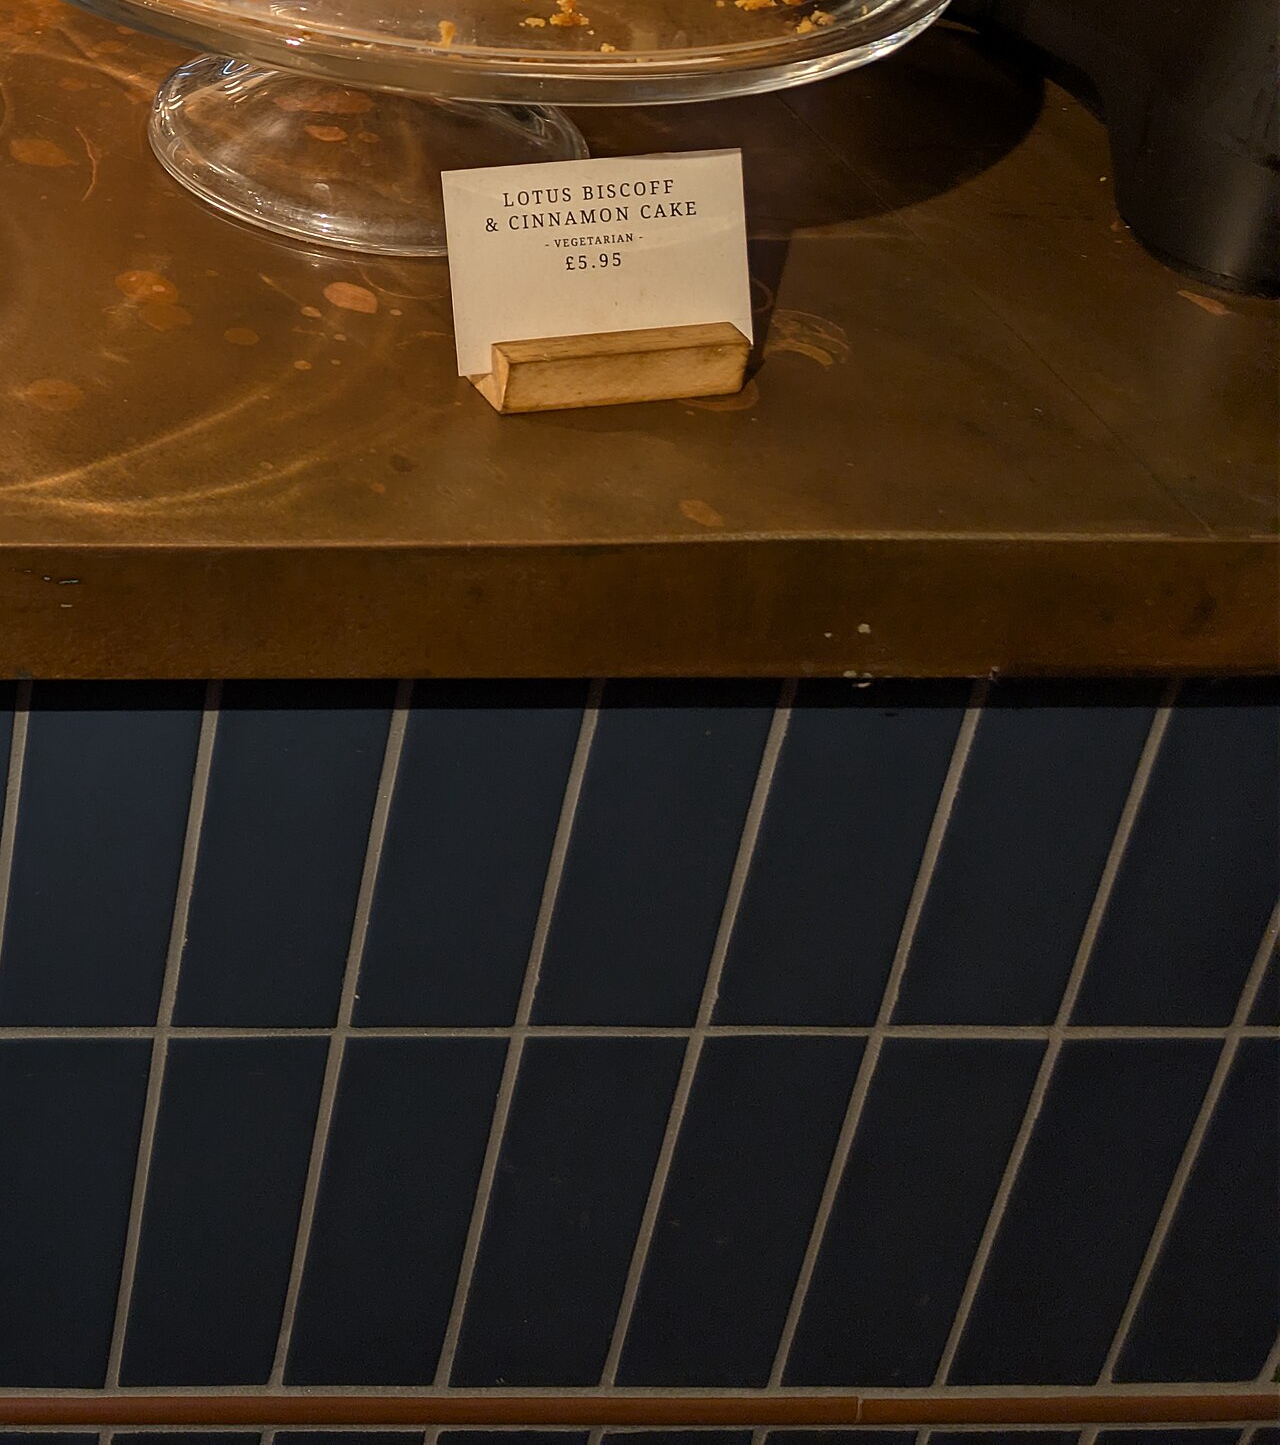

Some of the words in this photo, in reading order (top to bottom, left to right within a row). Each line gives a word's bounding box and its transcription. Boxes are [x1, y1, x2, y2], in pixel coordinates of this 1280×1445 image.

[503, 187, 572, 208] LOTUS
[582, 179, 675, 201] BISCOFF
[485, 217, 500, 233] &
[508, 206, 630, 231] CINNAMON
[640, 201, 698, 219] CAKE
[554, 232, 634, 248] VEGETARIAN
[565, 251, 622, 271] £5.95
